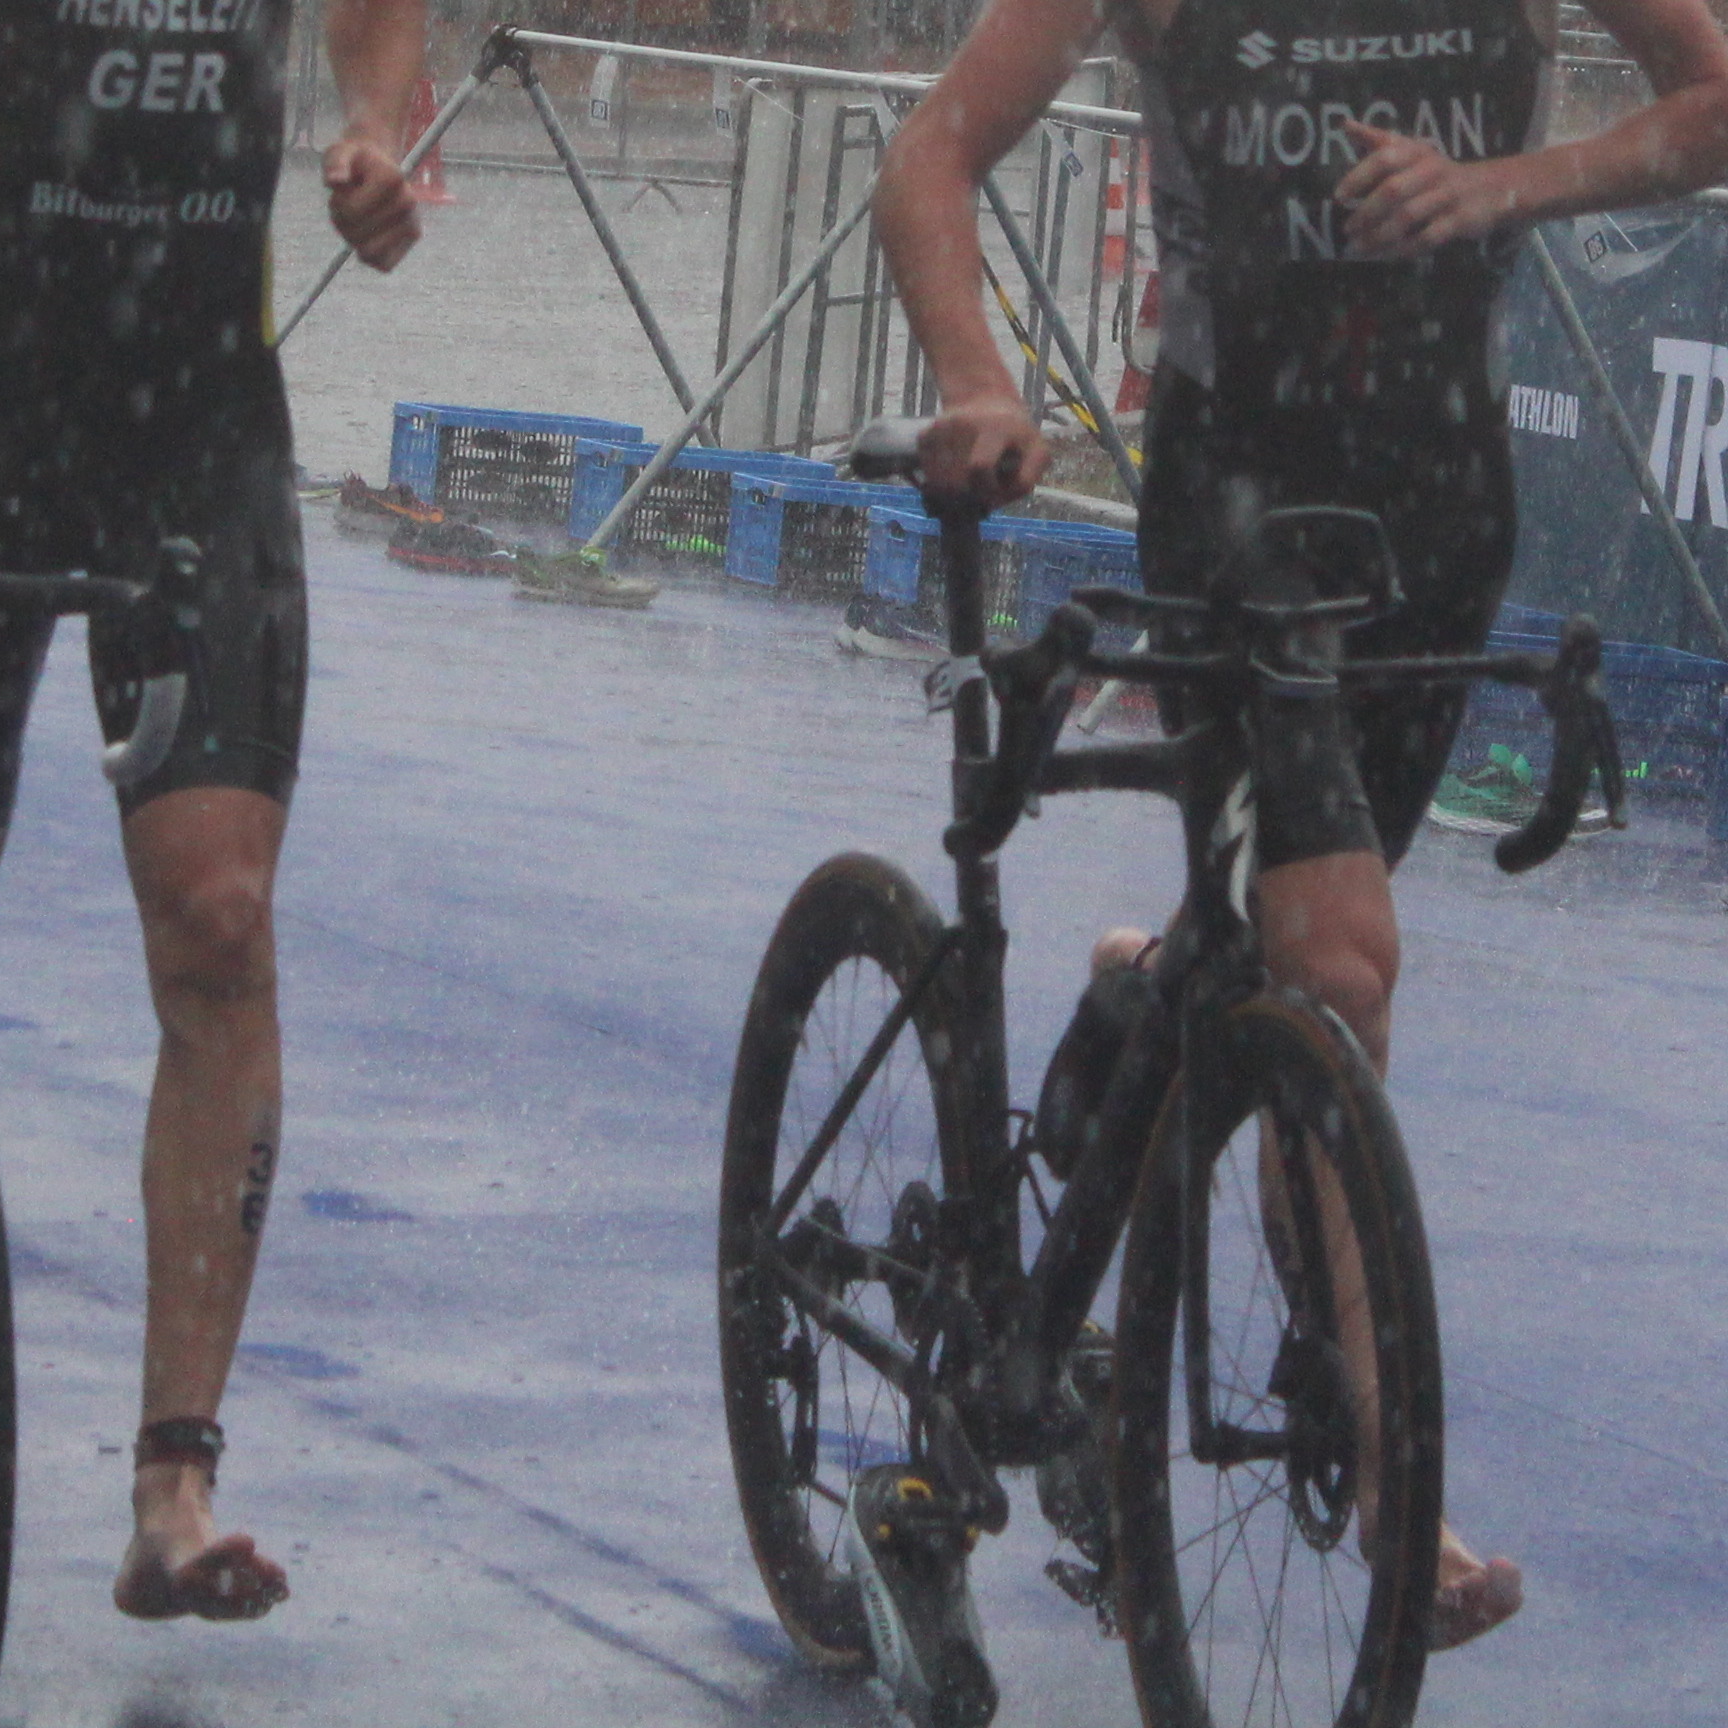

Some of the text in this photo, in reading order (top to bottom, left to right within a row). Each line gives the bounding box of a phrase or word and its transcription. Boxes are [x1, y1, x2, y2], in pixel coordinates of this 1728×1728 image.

[1291, 28, 1474, 63] SUZUKI
[88, 49, 227, 112] GER
[1509, 383, 1579, 440] ATHLON
